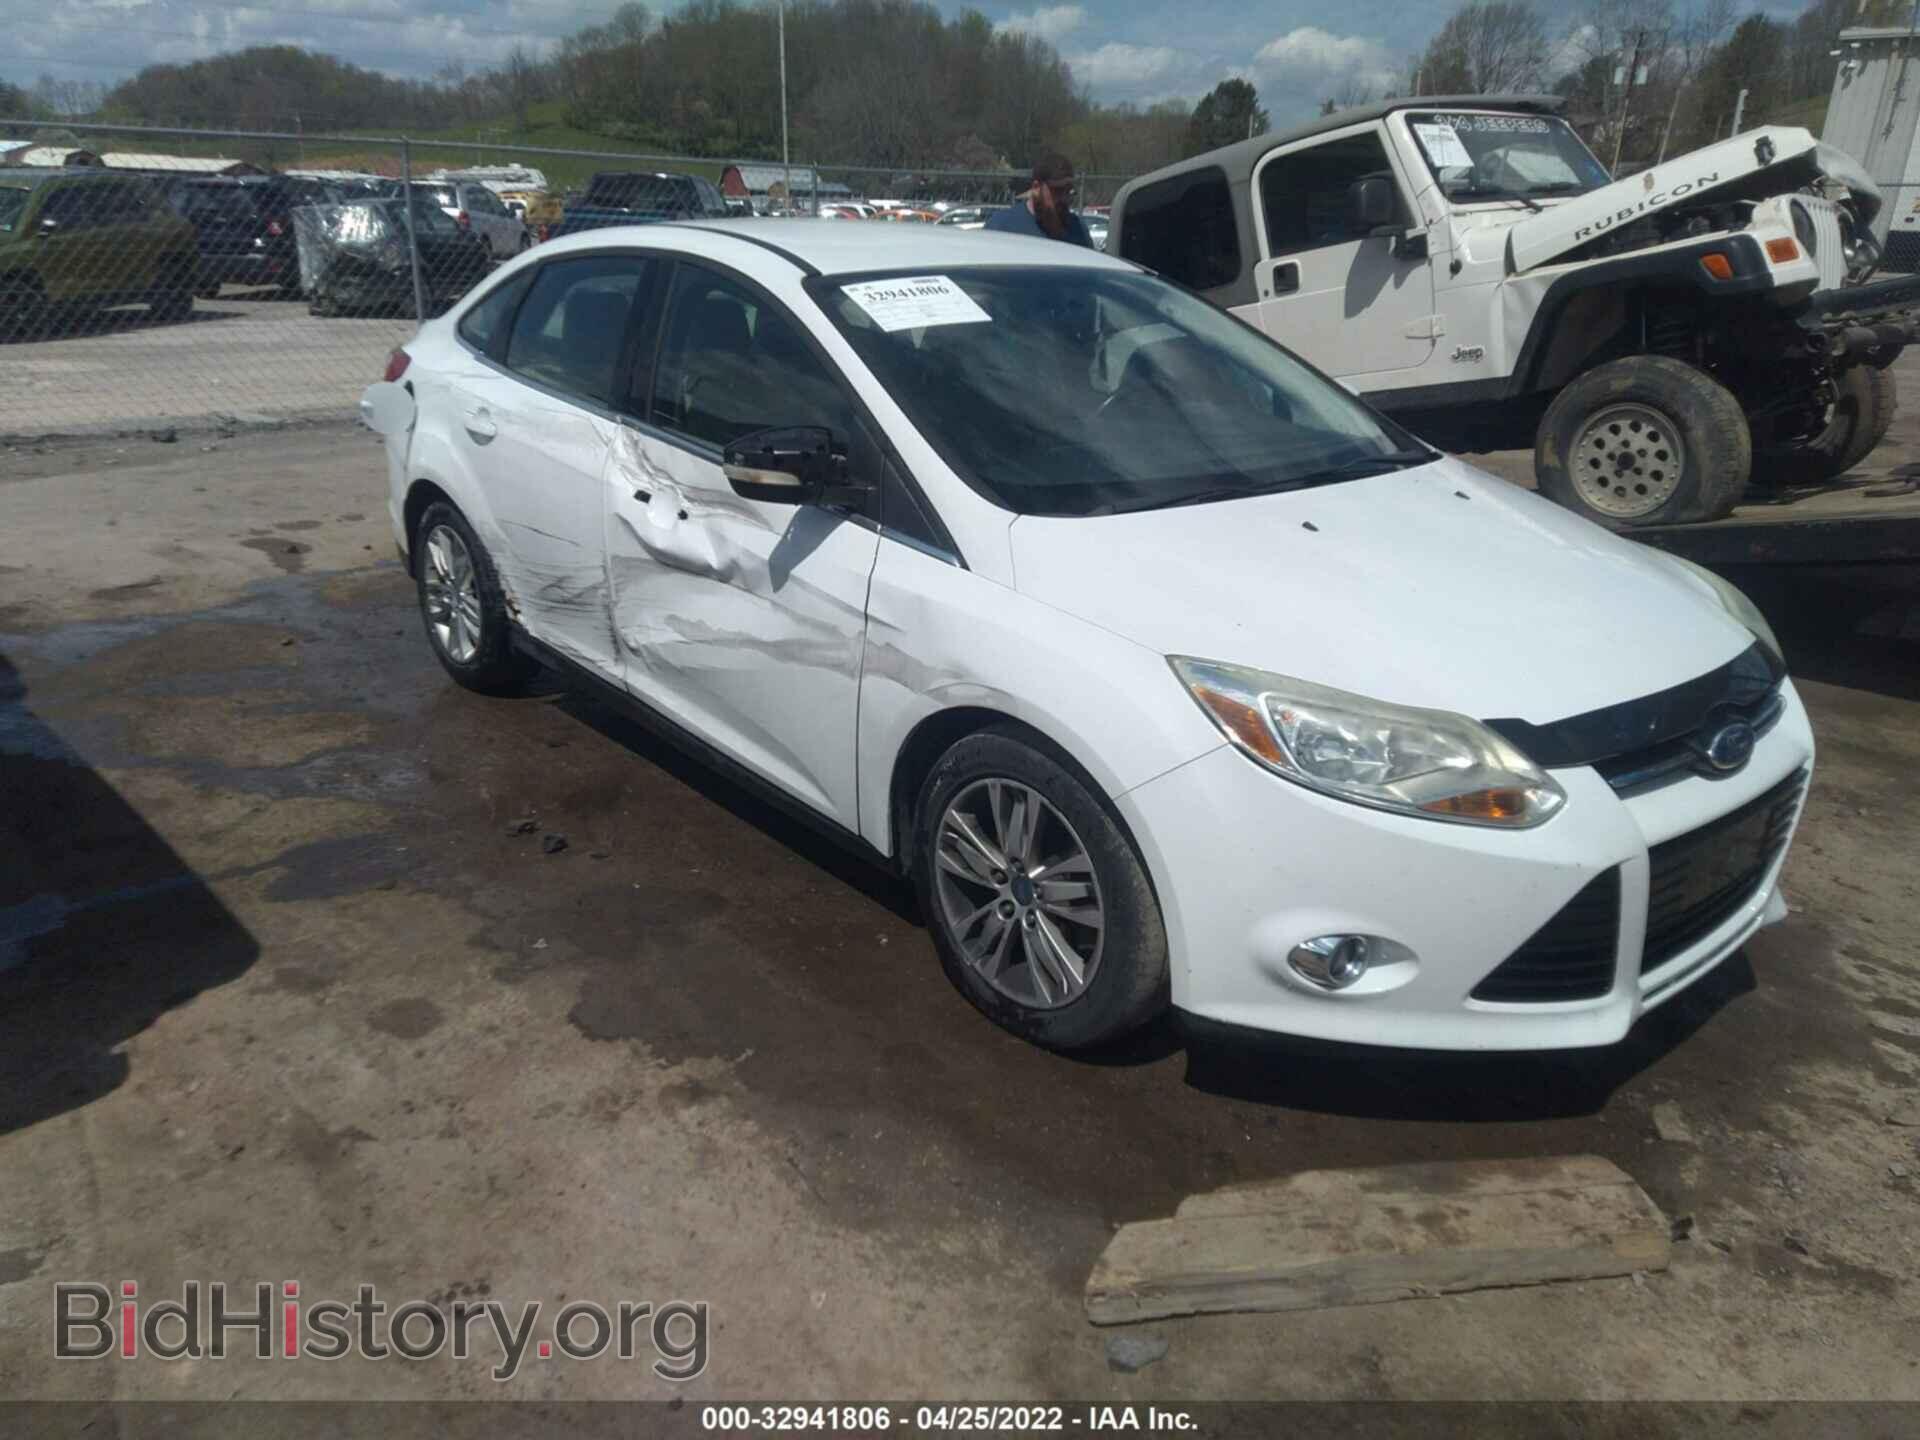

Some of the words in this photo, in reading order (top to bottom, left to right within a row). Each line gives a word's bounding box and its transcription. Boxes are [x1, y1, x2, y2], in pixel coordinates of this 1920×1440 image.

[1574, 172, 1719, 240] RUBICON
[864, 285, 950, 302] 32941806
[1451, 346, 1484, 362] Jeep
